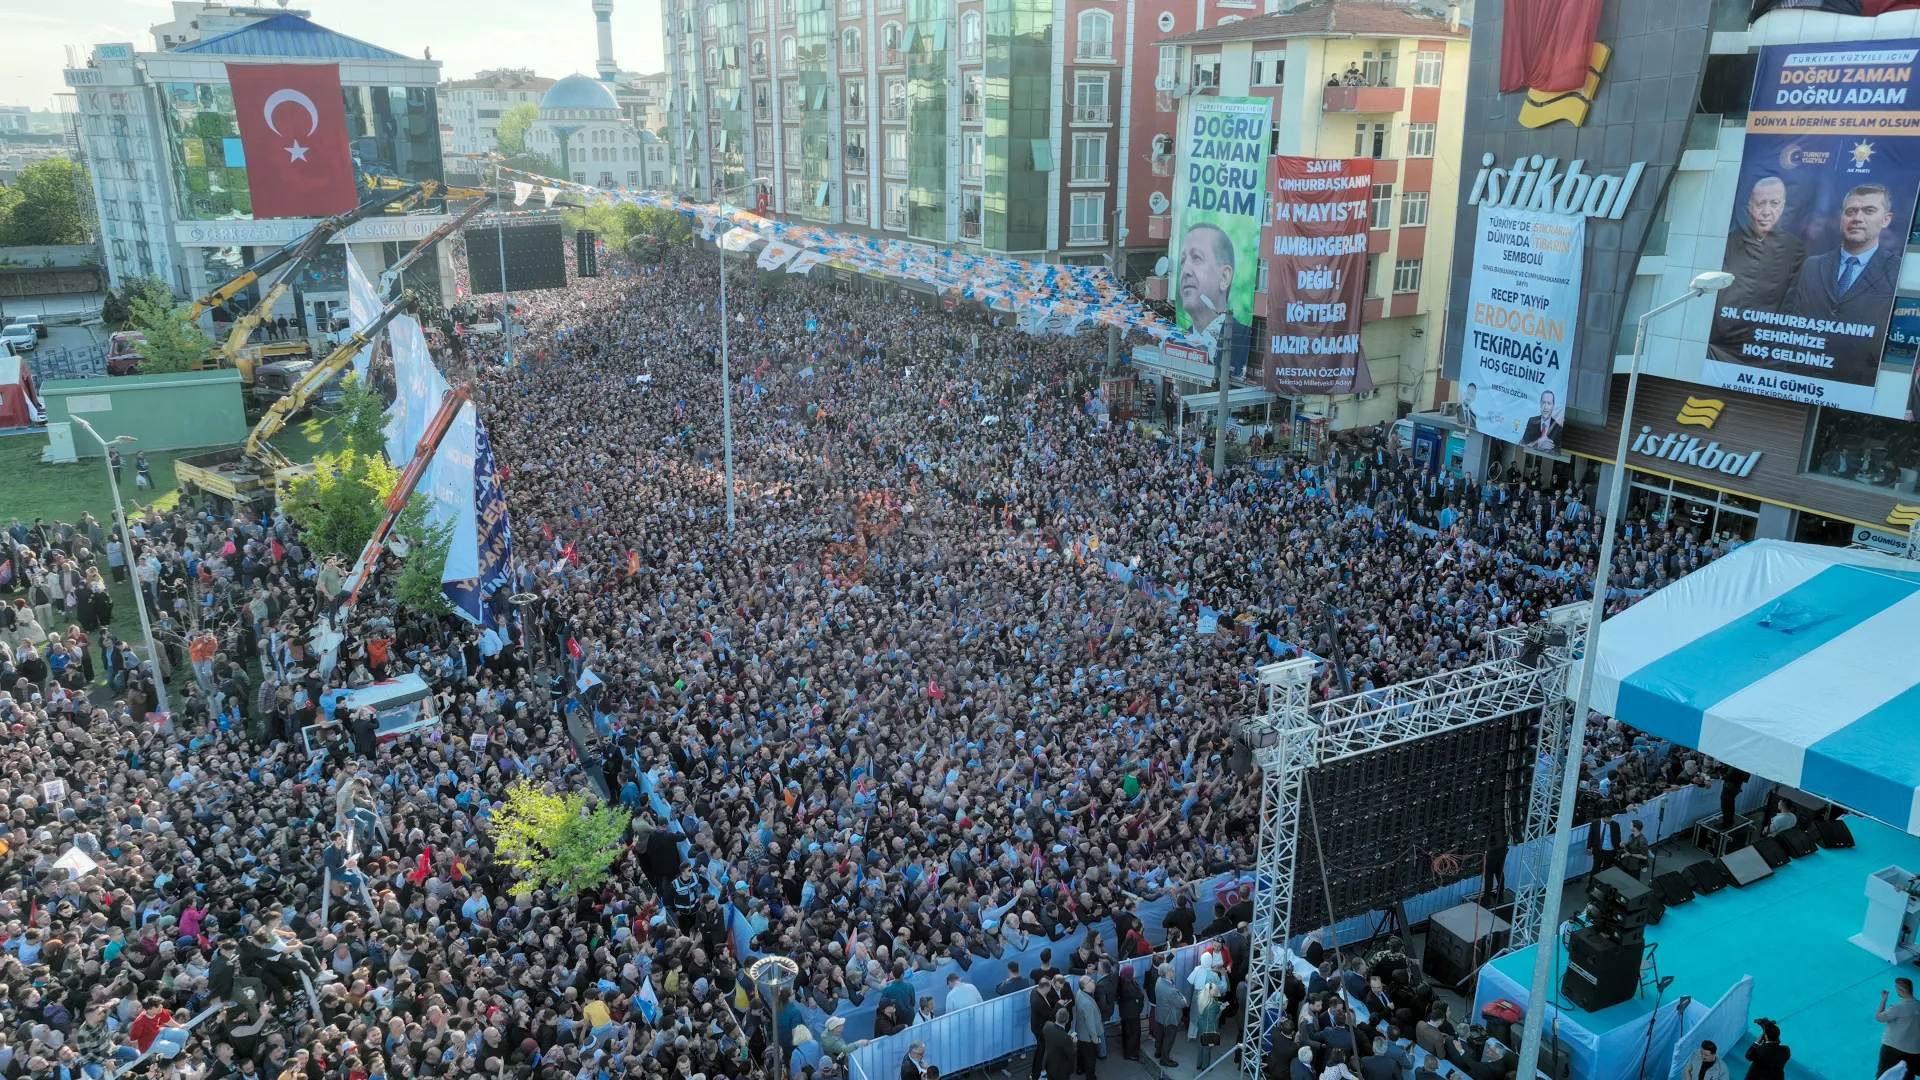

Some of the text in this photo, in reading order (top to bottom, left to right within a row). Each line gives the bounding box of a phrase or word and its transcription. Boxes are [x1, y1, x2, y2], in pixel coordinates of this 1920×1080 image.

[101, 45, 126, 58] SIEMENS
[1793, 52, 1909, 63] TÜRKİYE YÜZYILI İÇİN
[1780, 67, 1912, 84] DOĞRU ZAMAN
[1776, 86, 1907, 104] DOĞRU ADAM
[1194, 114, 1263, 140] DOĞRU
[1754, 116, 1787, 126] DÜNYA
[1790, 116, 1837, 127] LİDERİNE
[1839, 118, 1875, 127] SELAM
[1191, 139, 1260, 163] ZAMAN
[1189, 162, 1257, 190] DOĞRU
[1306, 160, 1341, 173] SAYIN
[1278, 175, 1370, 191] CUMHURBAŞKANIM
[1468, 152, 1647, 219] istikbal
[1187, 186, 1256, 216] ADAM
[1276, 202, 1290, 221] 14
[204, 224, 281, 242] ÇERKEZKÖY
[414, 223, 438, 236] ODA
[1487, 229, 1530, 248] DÜNYADA
[1503, 250, 1543, 266] SEMBOLÜ
[1297, 264, 1333, 290] DEĞİL
[1491, 288, 1550, 310] RECEP TAYYİP
[1286, 300, 1346, 322] KÖFTELER
[1474, 301, 1565, 343] ERDOĞAN
[1720, 306, 1875, 338] SN. CUMHURBAŞKANIM
[1271, 334, 1359, 354] HAZIR OLACAK
[1754, 328, 1826, 350] ŞEHRİMİZE
[1742, 344, 1835, 369] HOŞ GELDİNİZ
[1276, 368, 1317, 377] MESTAN
[1319, 366, 1355, 377] ÖZCAN
[1480, 356, 1545, 385] HOŞ GELDİNİZ
[1733, 384, 1754, 394] PARTİ
[1756, 387, 1793, 400] TEKİRDAĞ
[1737, 373, 1824, 398] AV. ALİ GÜMÜŞ
[1630, 425, 1763, 478] istikbal
